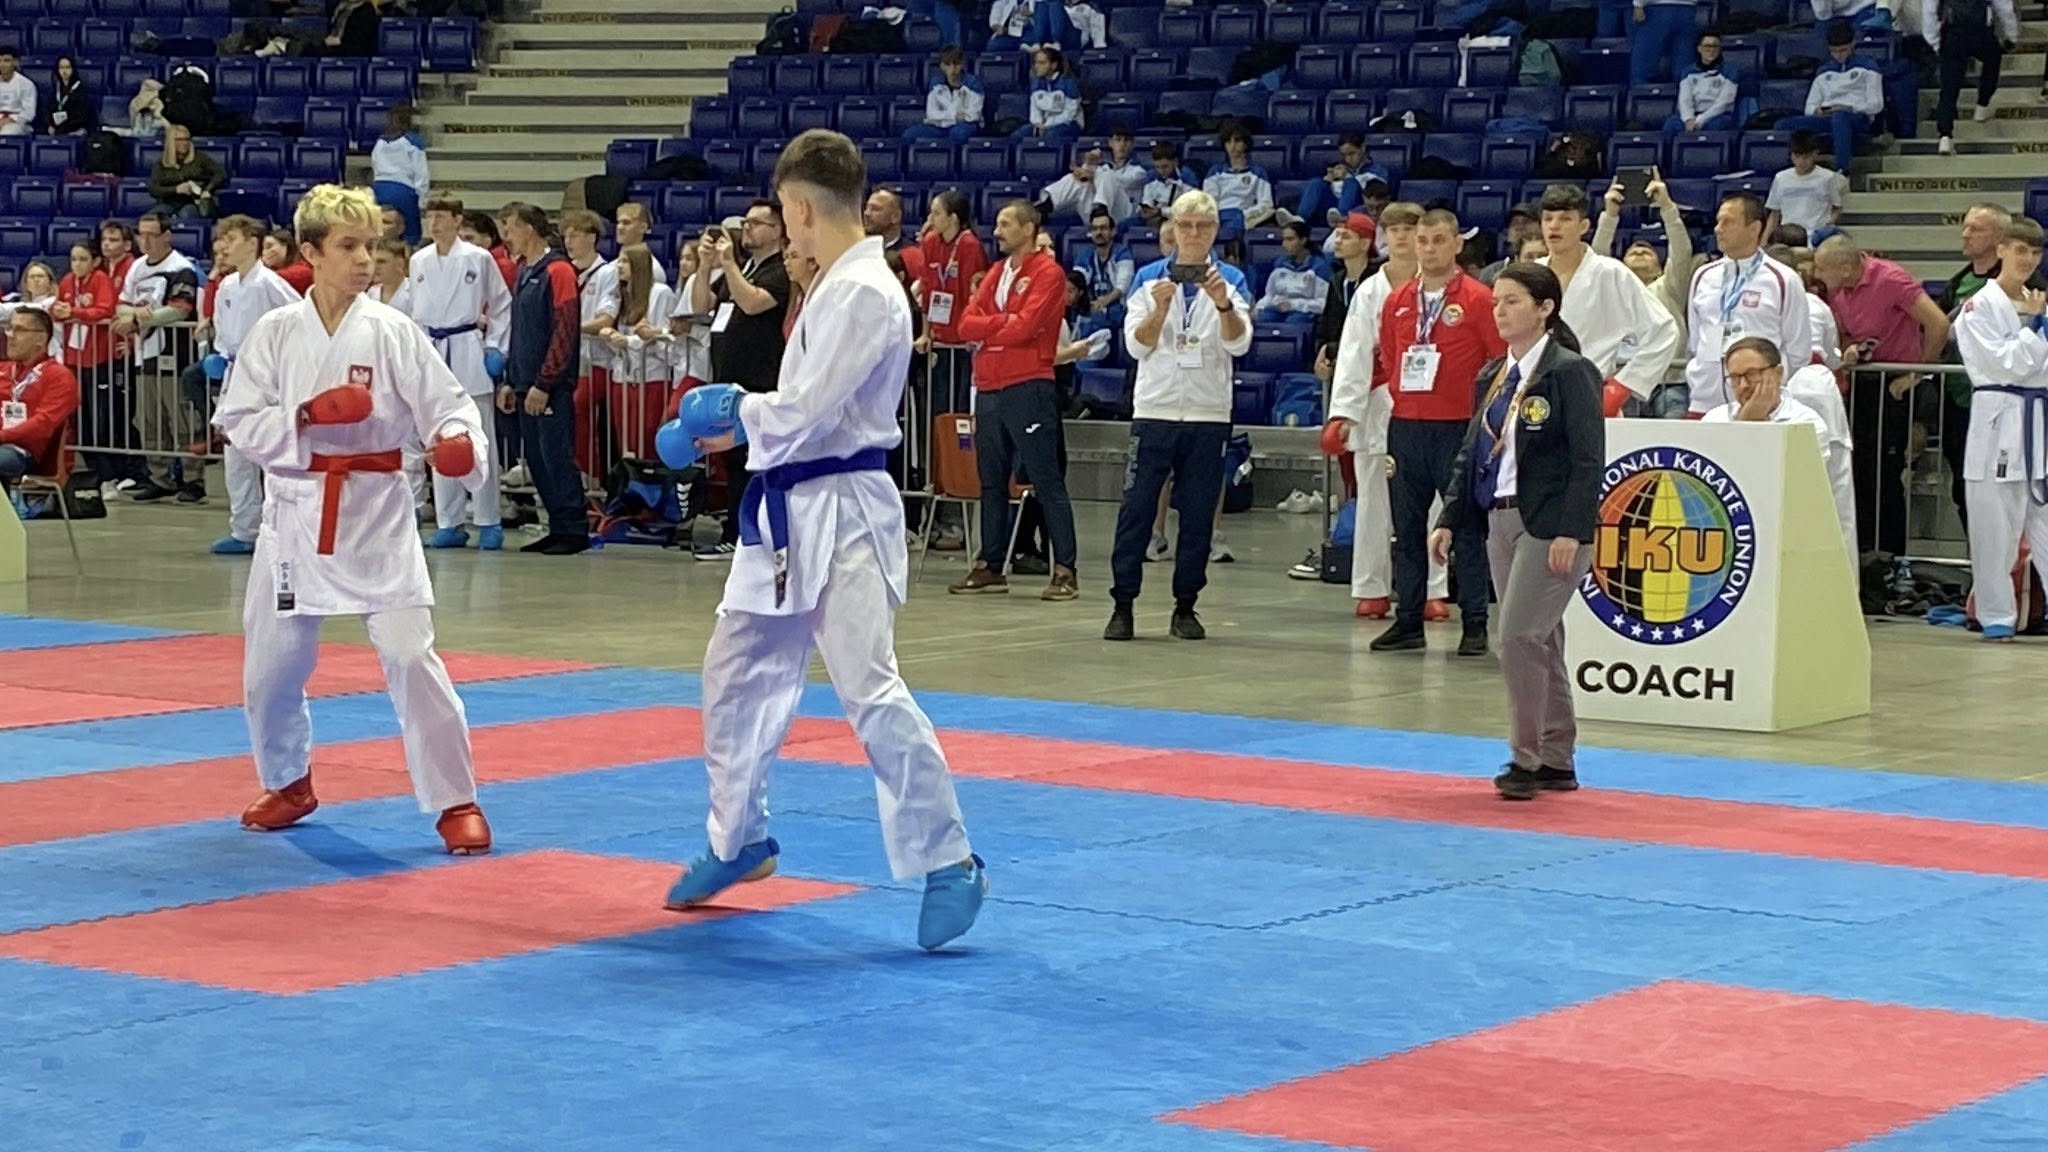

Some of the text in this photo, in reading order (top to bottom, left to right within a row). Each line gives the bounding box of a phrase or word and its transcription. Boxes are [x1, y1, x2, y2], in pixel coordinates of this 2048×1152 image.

[1598, 524, 1726, 575] IKU
[1673, 452, 1744, 516] KARATE
[1720, 524, 1752, 605] UNION
[1576, 660, 1734, 701] COACH
